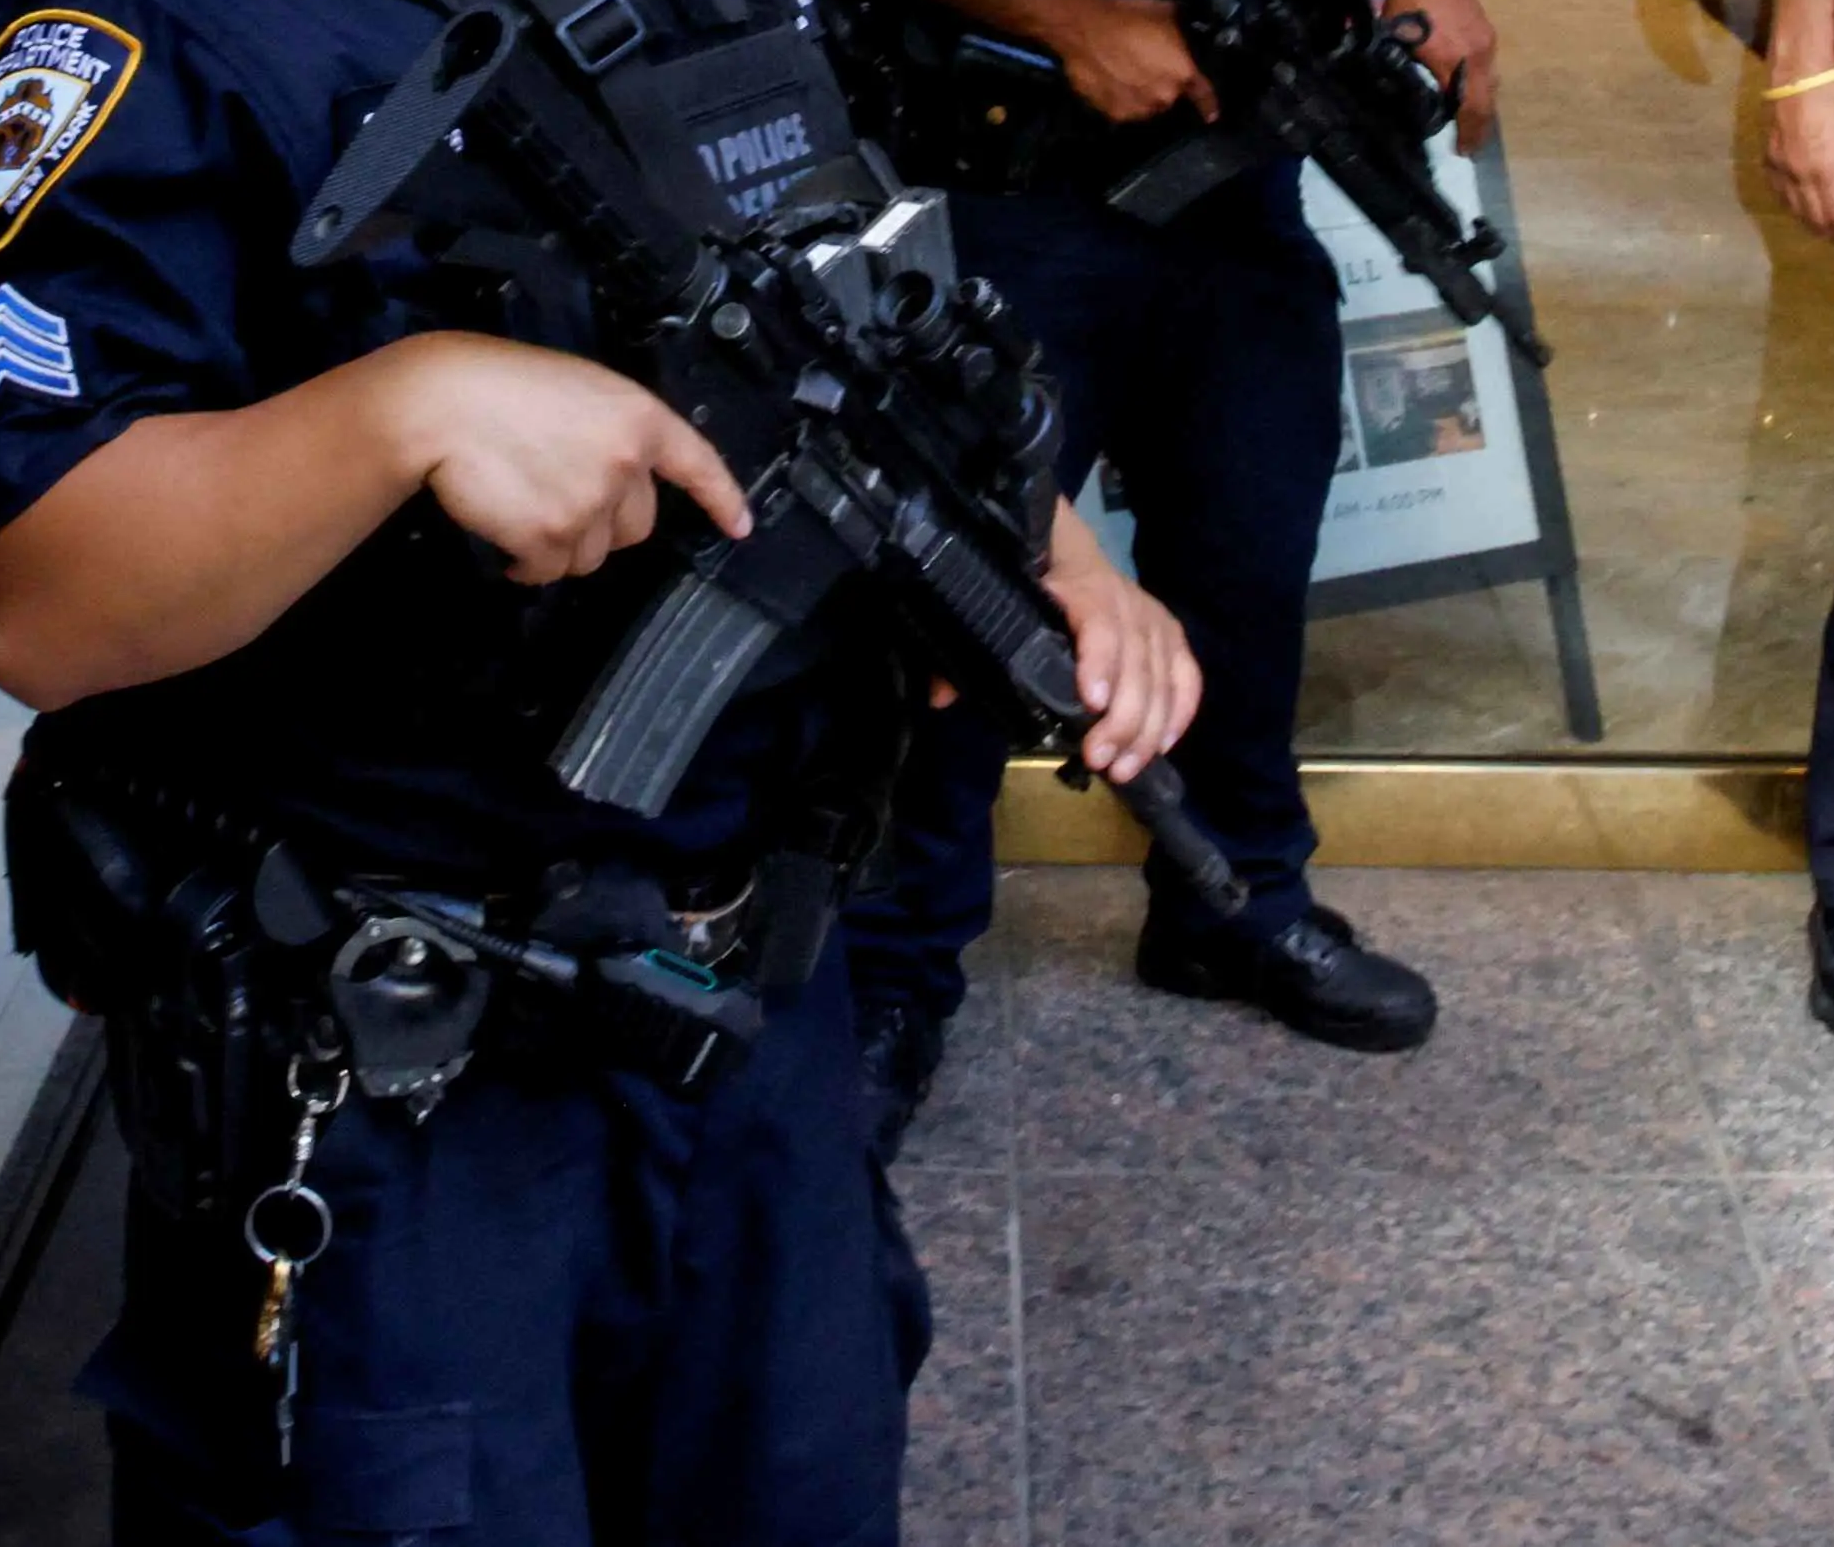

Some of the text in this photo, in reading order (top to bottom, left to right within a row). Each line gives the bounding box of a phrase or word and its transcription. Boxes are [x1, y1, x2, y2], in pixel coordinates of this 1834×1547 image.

[11, 22, 89, 50] POLICE
[43, 99, 99, 162] YORK
[718, 112, 813, 183] POLICE
